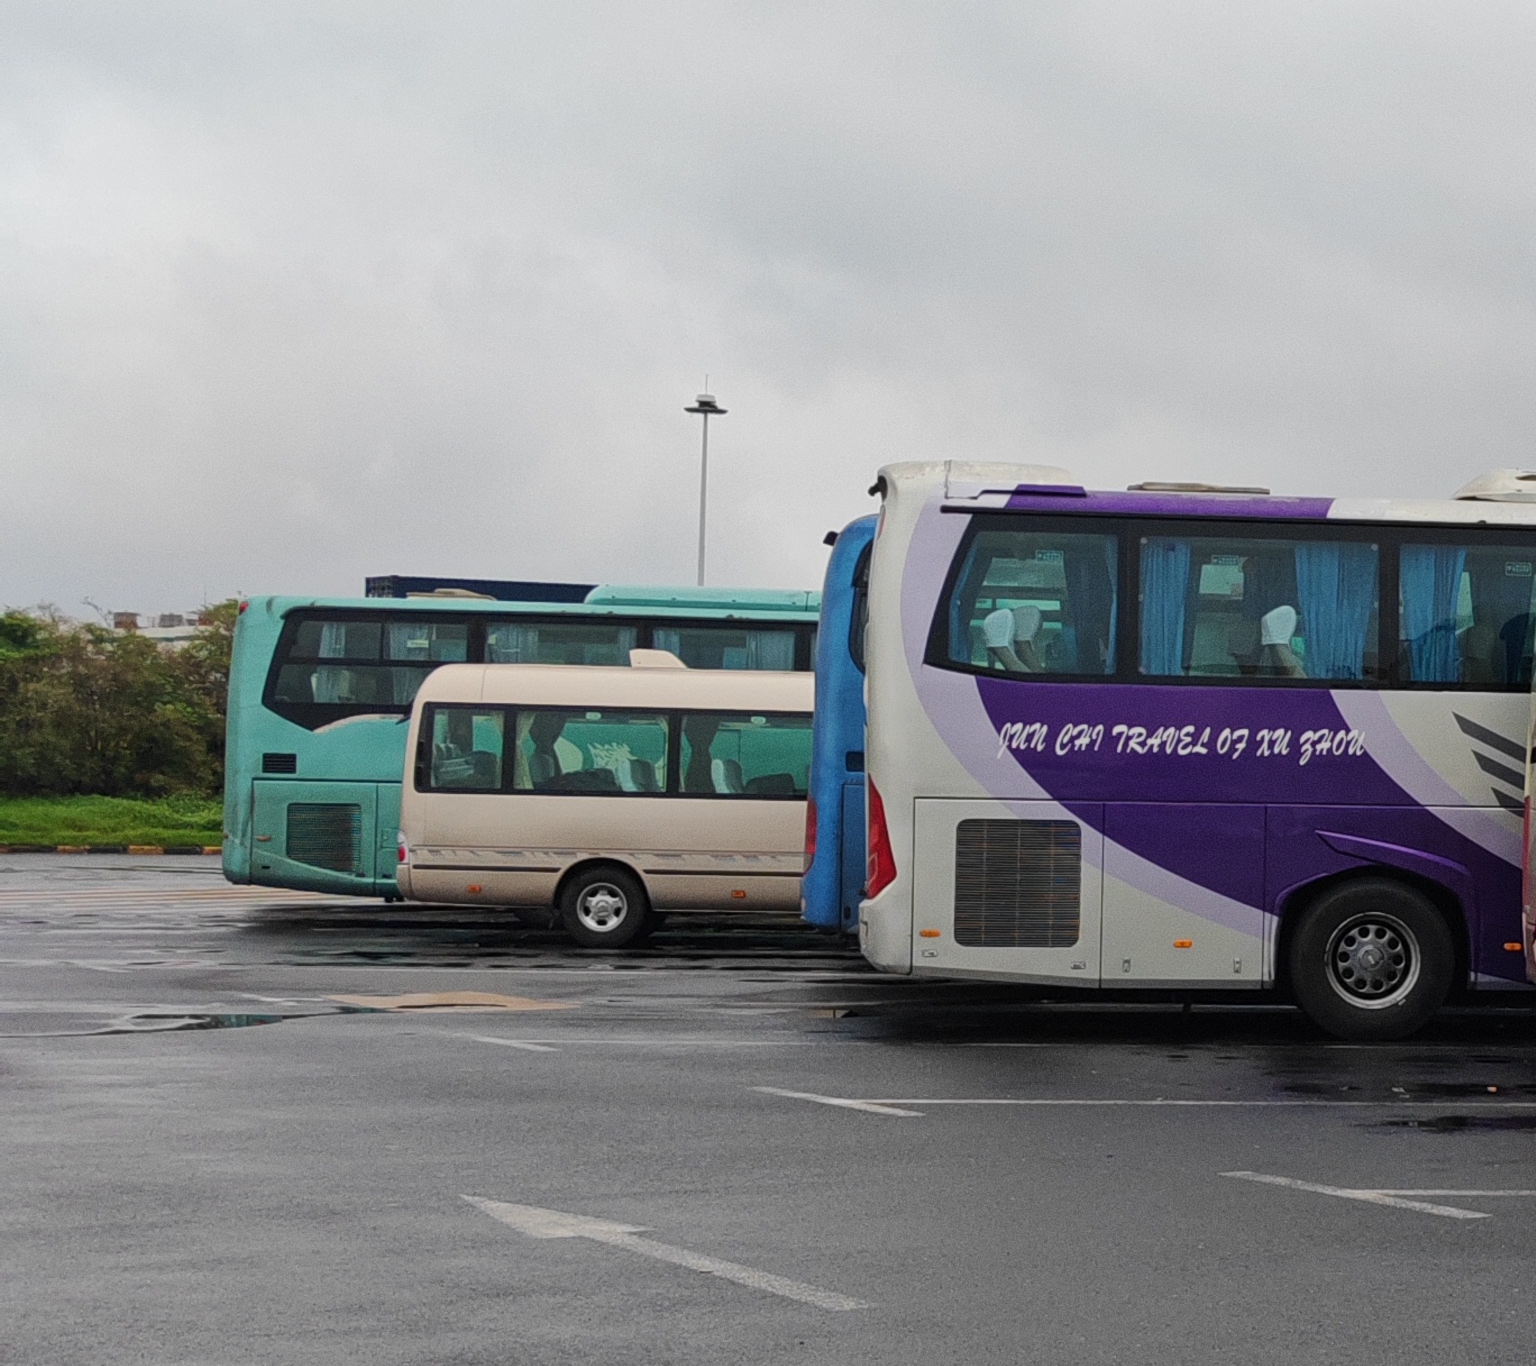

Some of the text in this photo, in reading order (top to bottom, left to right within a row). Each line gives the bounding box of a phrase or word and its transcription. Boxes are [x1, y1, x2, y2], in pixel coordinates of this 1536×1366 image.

[997, 722, 1365, 766] JUN CHI TRAVEL OF XU ZHOU
